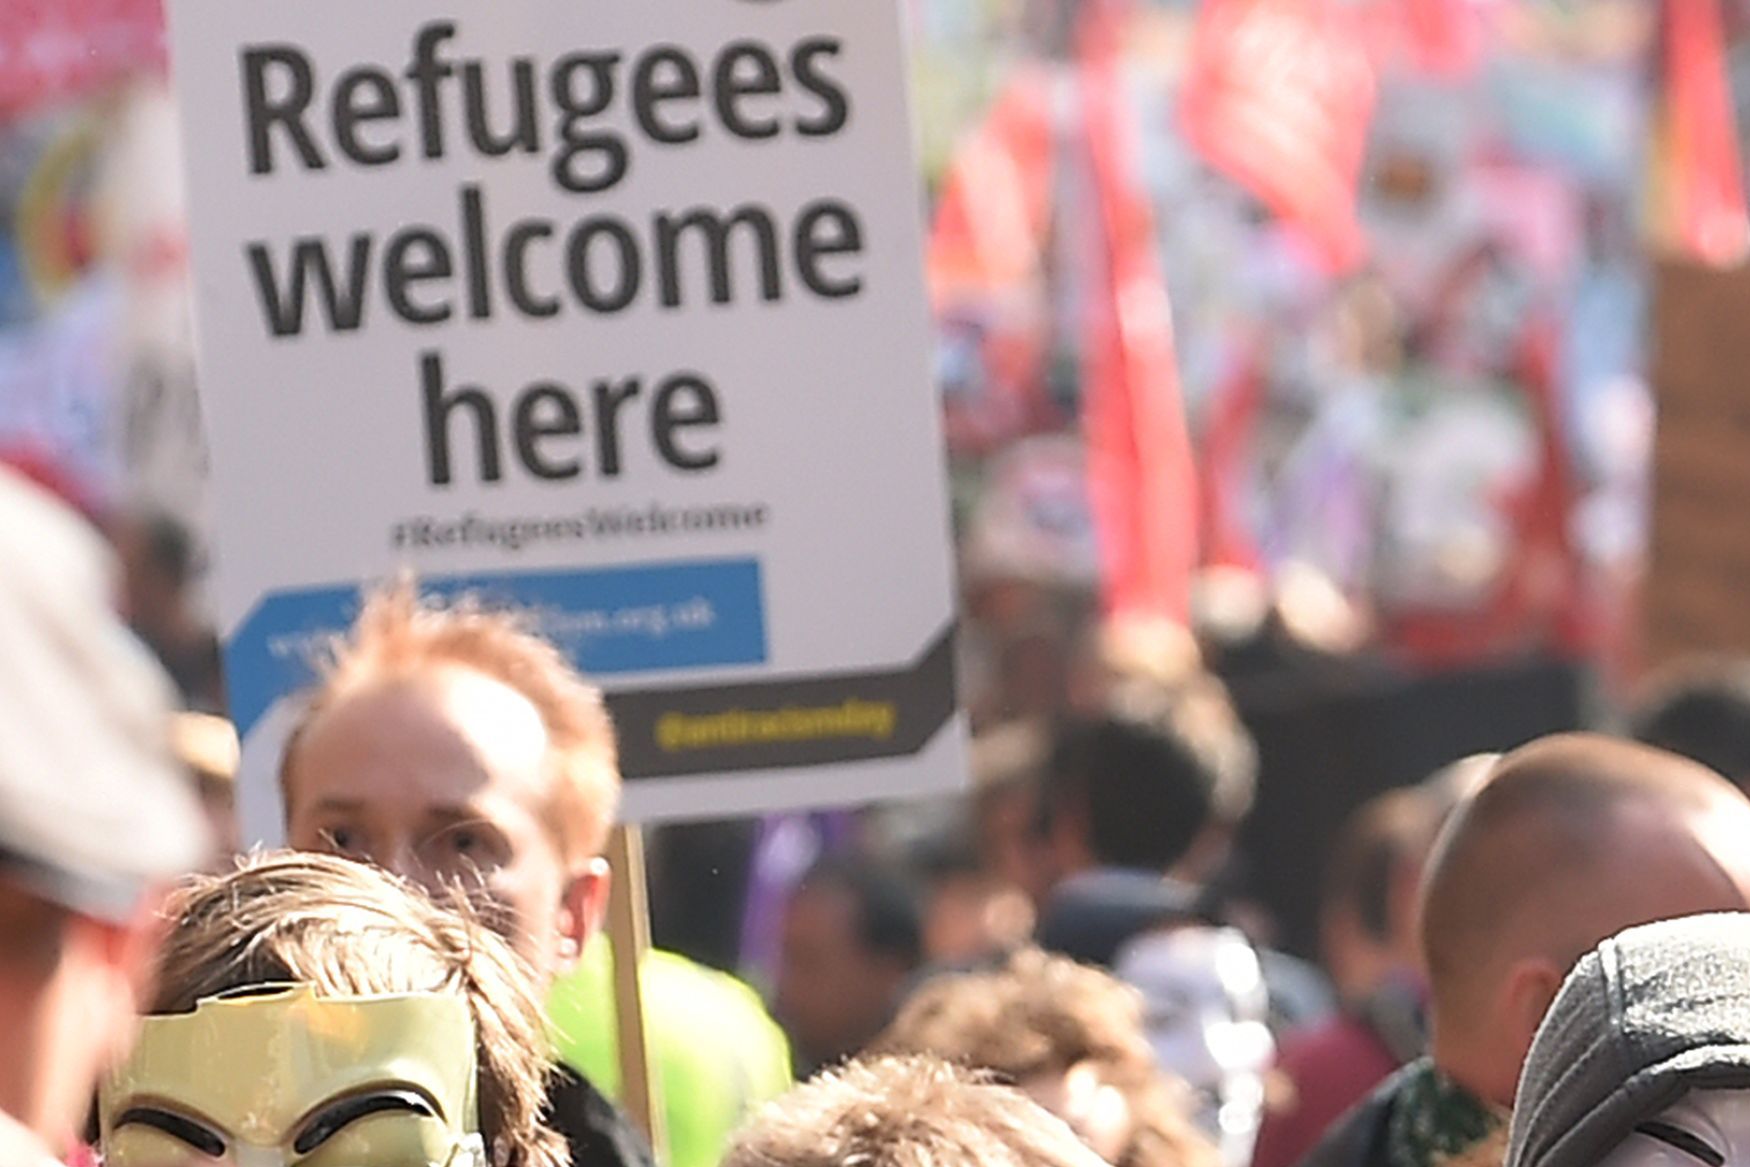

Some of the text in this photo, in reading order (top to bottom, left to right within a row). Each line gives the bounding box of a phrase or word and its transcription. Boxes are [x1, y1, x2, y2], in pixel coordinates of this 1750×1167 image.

[240, 20, 851, 195] Refugees
[245, 183, 865, 339] welcome
[418, 350, 722, 488] here
